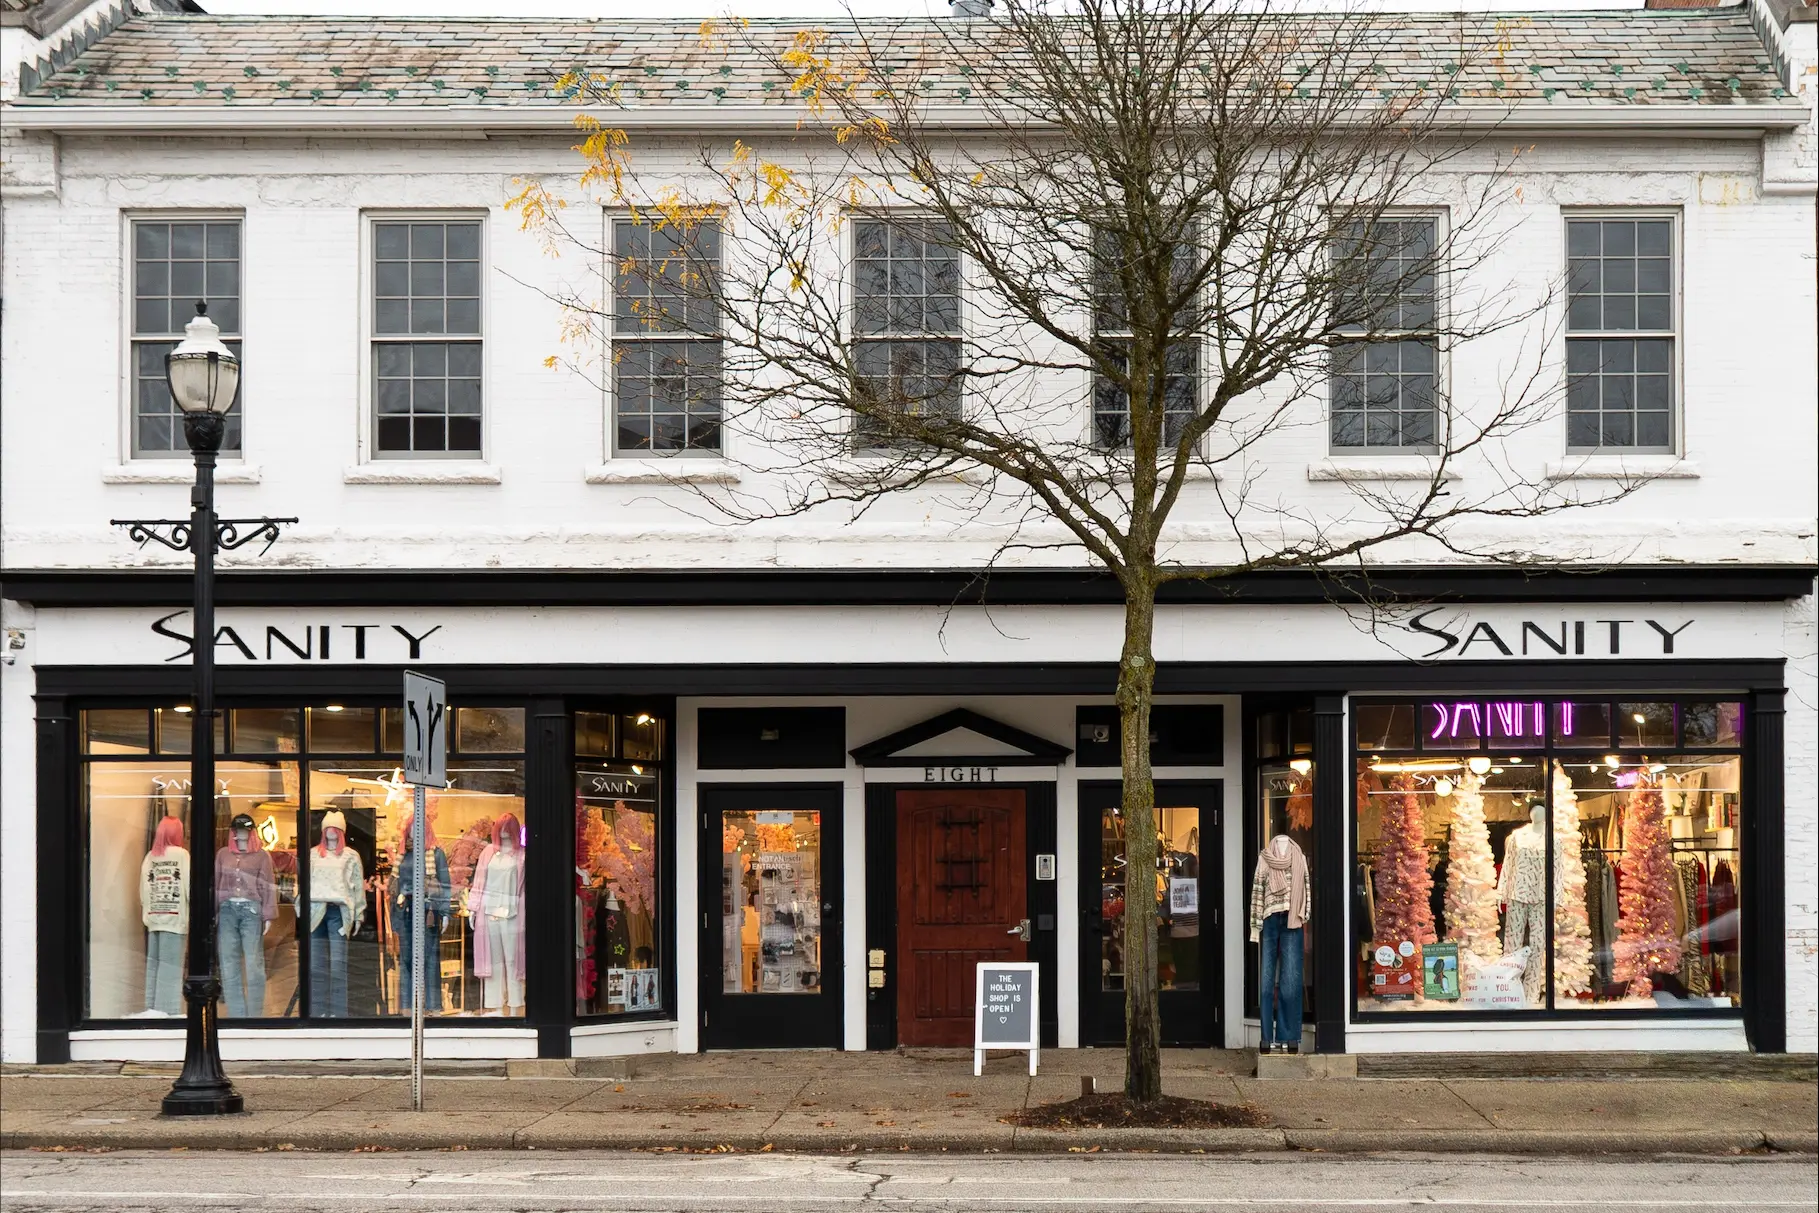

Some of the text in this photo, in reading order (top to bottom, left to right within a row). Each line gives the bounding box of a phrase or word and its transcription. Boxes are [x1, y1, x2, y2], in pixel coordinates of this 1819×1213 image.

[151, 610, 442, 661] SANITY
[1408, 606, 1695, 658] SANITY
[405, 755, 422, 772] ONLY
[151, 774, 233, 790] SANY
[924, 767, 998, 782] EIGHT
[1412, 771, 1492, 786] SANIY
[591, 776, 640, 794] SANITY
[1269, 777, 1304, 791] SANY
[759, 855, 774, 863] NOT
[774, 855, 785, 863] AN
[1113, 853, 1188, 868] SITY
[998, 974, 1013, 983] THE
[990, 983, 1021, 992] HOLIDAY
[989, 994, 1021, 1003] SHOP IS
[989, 1003, 1014, 1013] OPEN!
